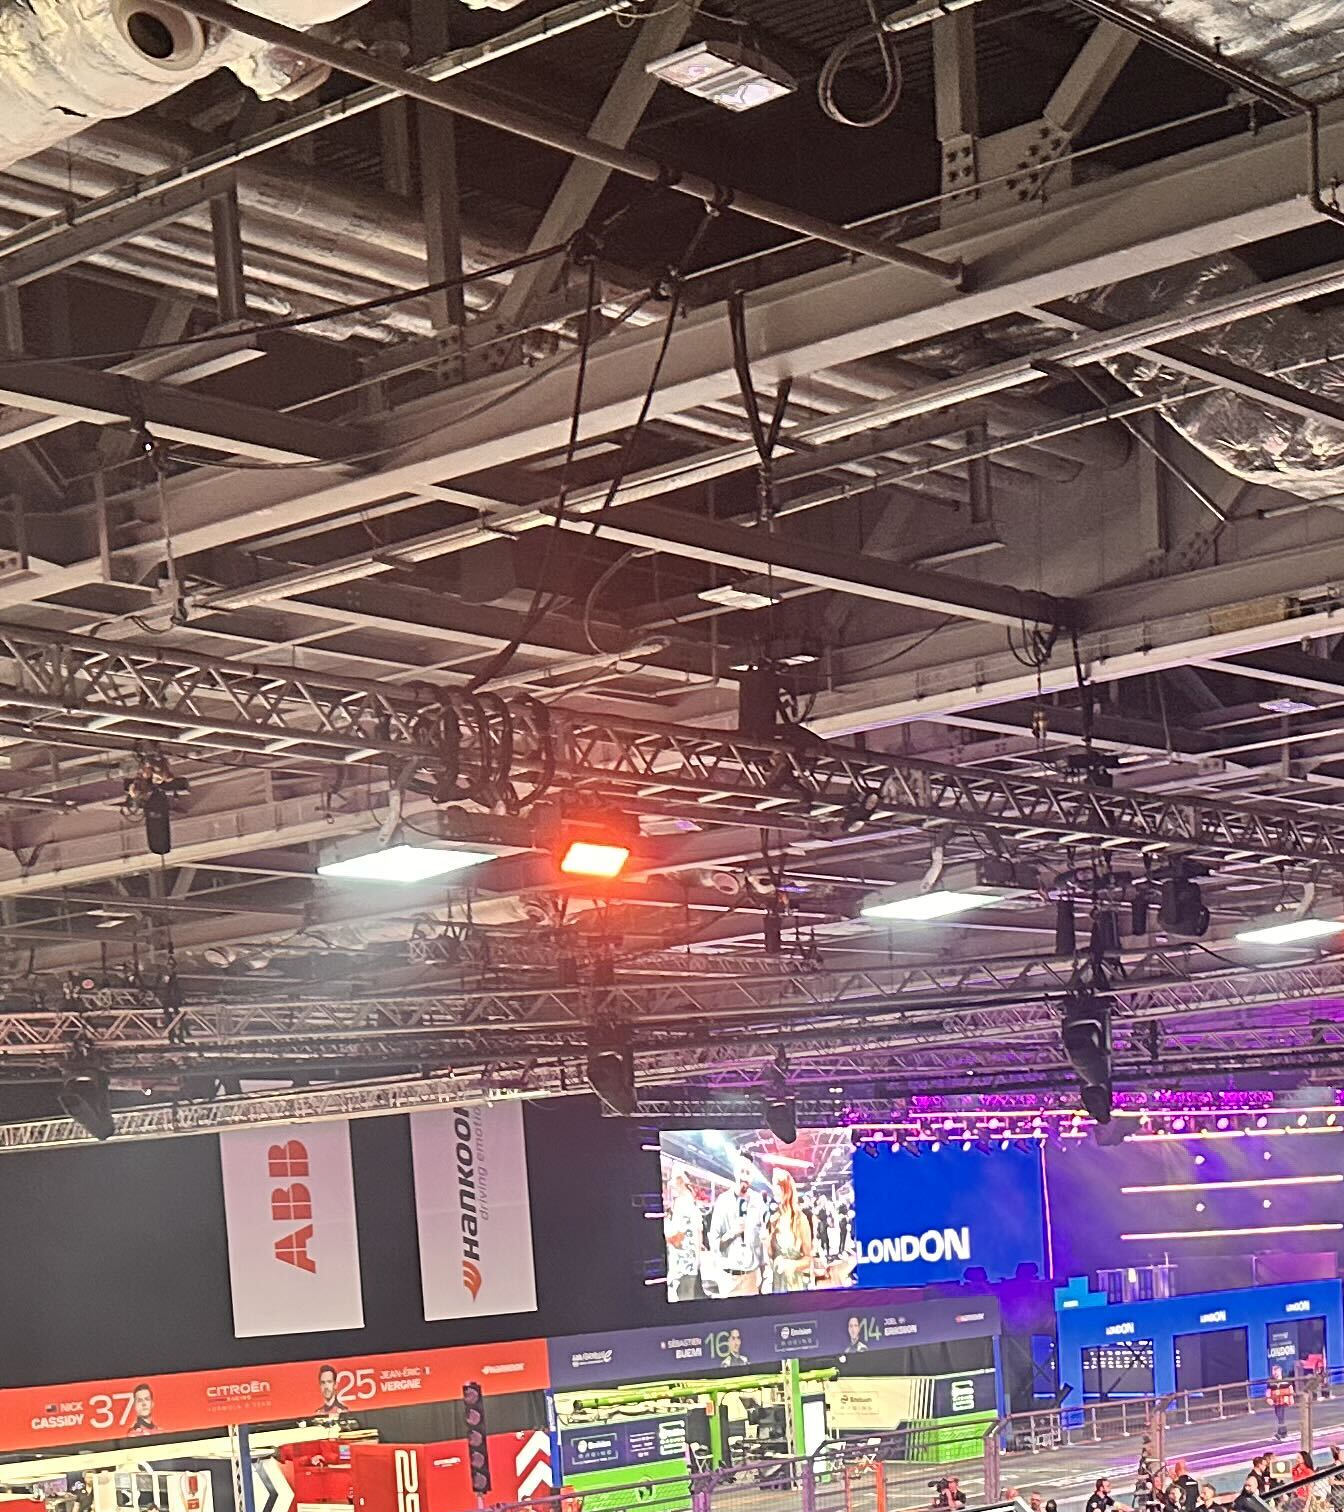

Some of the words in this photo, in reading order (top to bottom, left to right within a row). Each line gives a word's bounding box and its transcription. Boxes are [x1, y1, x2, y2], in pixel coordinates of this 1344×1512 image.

[268, 1139, 317, 1274] ABB
[476, 1165, 489, 1221] driving
[856, 1226, 971, 1264] LONDON
[859, 1317, 882, 1341] 14
[705, 1331, 730, 1359] 16
[336, 1369, 377, 1402] 25
[380, 1379, 421, 1392] VERGNE
[60, 1401, 83, 1412] NICK
[88, 1393, 135, 1430] 37
[31, 1413, 84, 1431] CASSIDY
